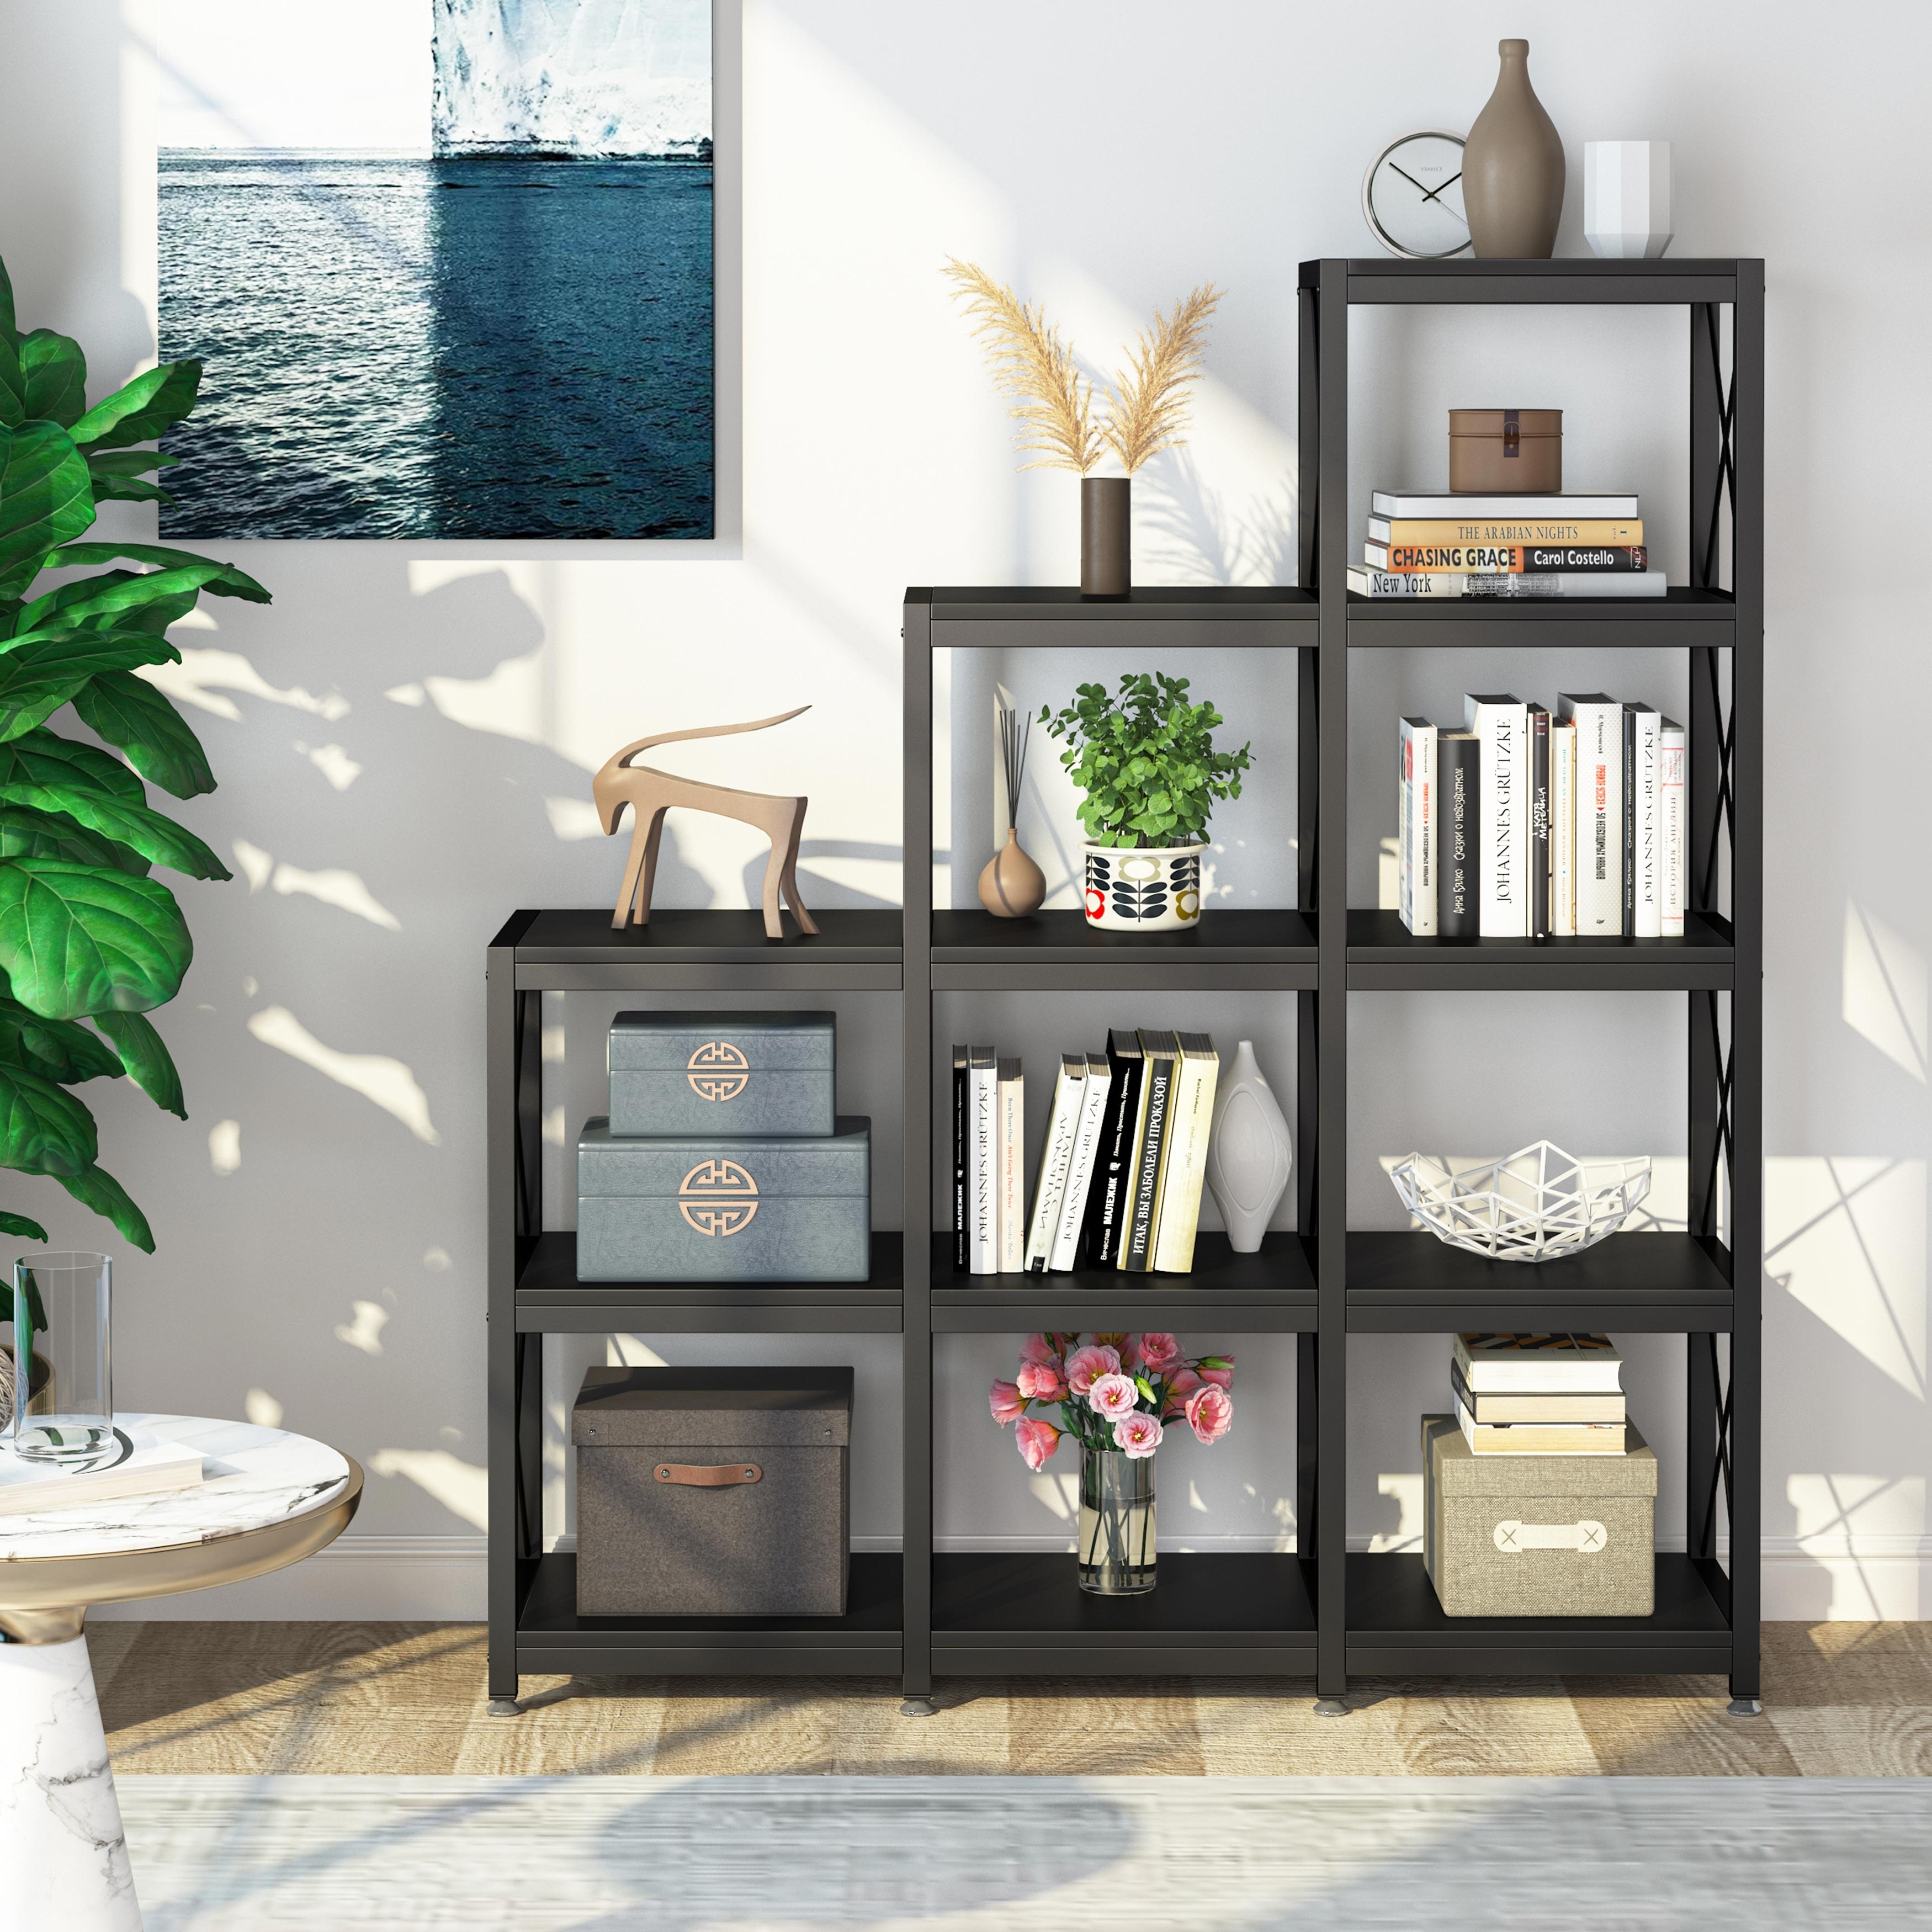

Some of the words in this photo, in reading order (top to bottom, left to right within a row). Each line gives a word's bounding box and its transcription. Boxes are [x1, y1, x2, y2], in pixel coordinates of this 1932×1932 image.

[1457, 526, 1480, 539] THE
[1484, 526, 1532, 539] ARABIAN
[1536, 526, 1579, 539] NIGHTS
[1392, 548, 1462, 567] CHASING
[1466, 548, 1516, 567] GRACE
[1533, 549, 1564, 566] Carol
[1567, 549, 1615, 566] Costello
[1373, 574, 1402, 593] New
[1403, 574, 1432, 593] York
[1495, 718, 1511, 804] GRÜTZKE
[1596, 765, 1606, 785] ПРАВИЛА
[1453, 768, 1466, 822] невозвратном
[1596, 787, 1606, 805] УСПЕХА
[1537, 787, 1547, 840] МЕТЕЛИЦА
[1453, 831, 1466, 861] Сказки
[1595, 820, 1606, 856] НЕОБХОДИМЫХ
[1496, 809, 1511, 904] JOHANNES
[1645, 811, 1653, 904] JOHANNES
[1453, 869, 1466, 893] Бялко
[1453, 895, 1464, 914] Анна
[1149, 1076, 1167, 1138] ПРОКАЗОЙ
[1141, 1142, 1159, 1201] ЗАБОЛЕЛИ
[979, 1161, 988, 1244] JOHANNES
[1063, 1161, 1086, 1243] JOHANNES
[1103, 1177, 1118, 1225] МАЛЕЖИК
[1138, 1201, 1151, 1221] ВЫ
[1101, 1228, 1111, 1260] Вячеслав
[1133, 1220, 1149, 1254] ИТАК,
